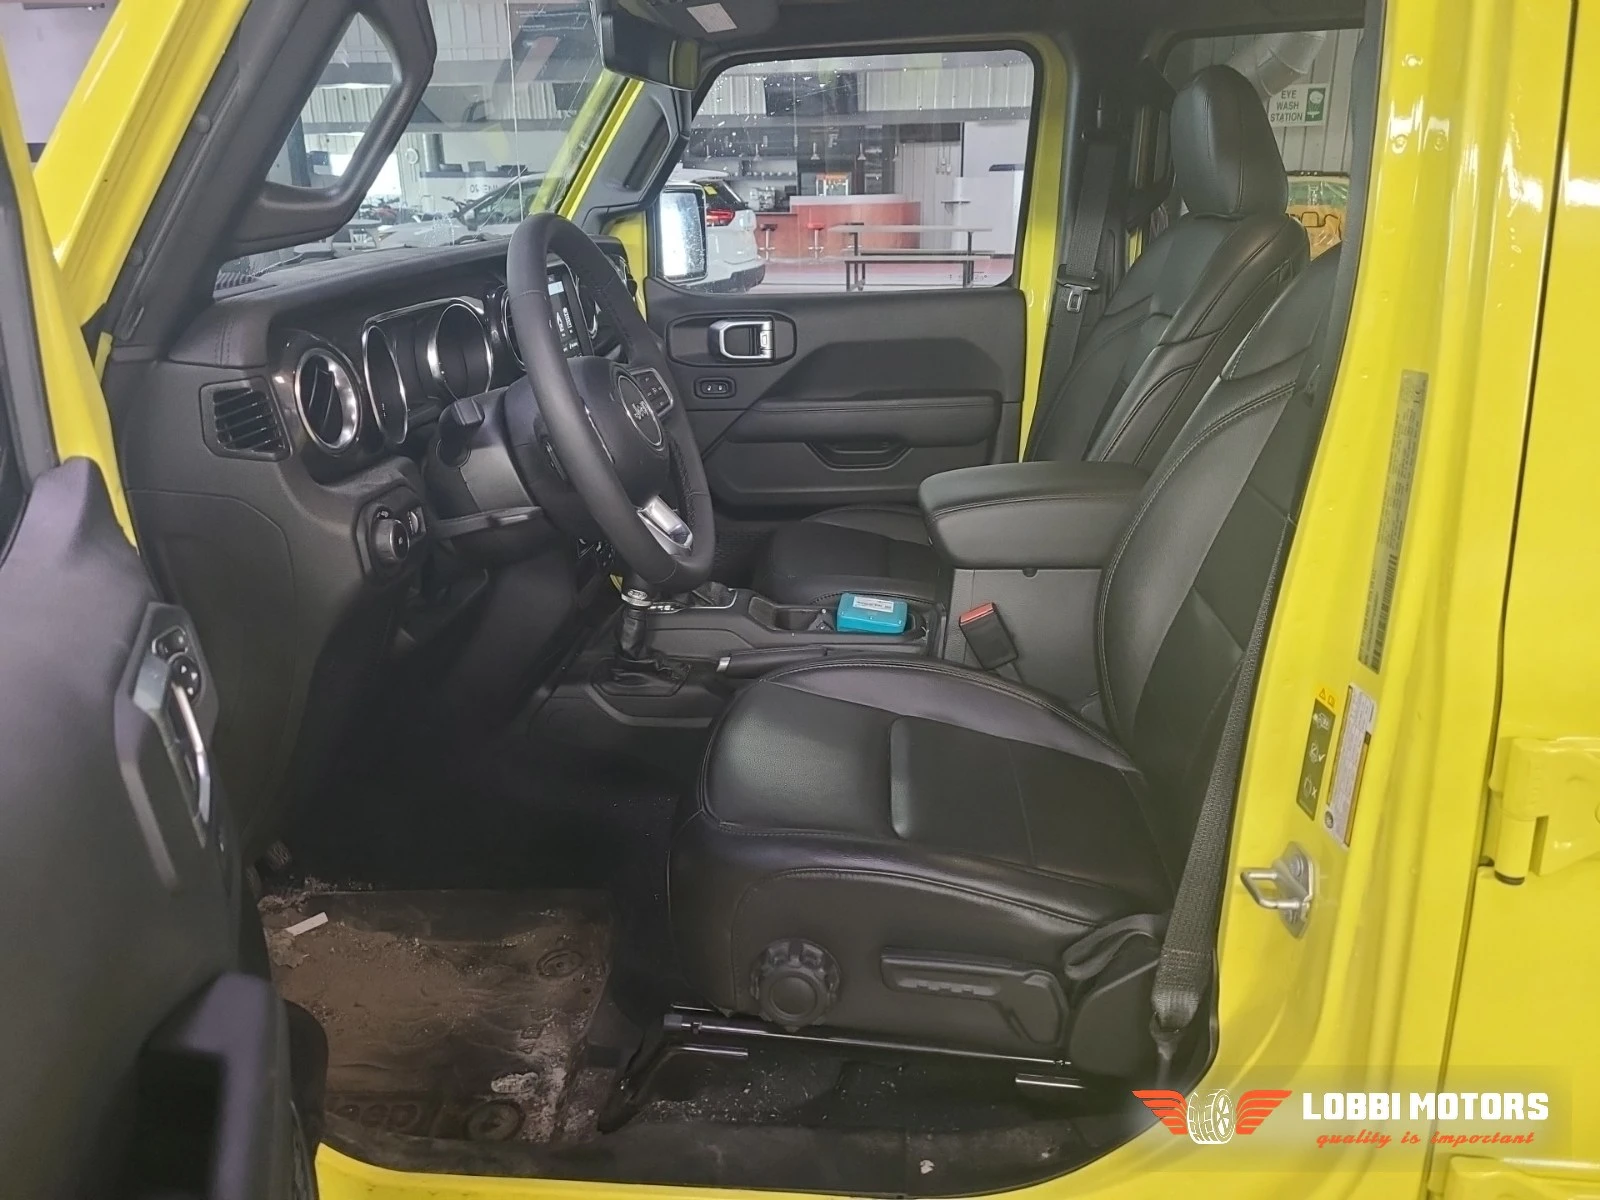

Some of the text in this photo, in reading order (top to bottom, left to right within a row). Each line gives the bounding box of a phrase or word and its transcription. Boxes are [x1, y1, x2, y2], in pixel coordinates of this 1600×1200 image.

[1281, 90, 1297, 99] EYE
[1276, 101, 1299, 110] WASH
[1270, 112, 1303, 122] STATION
